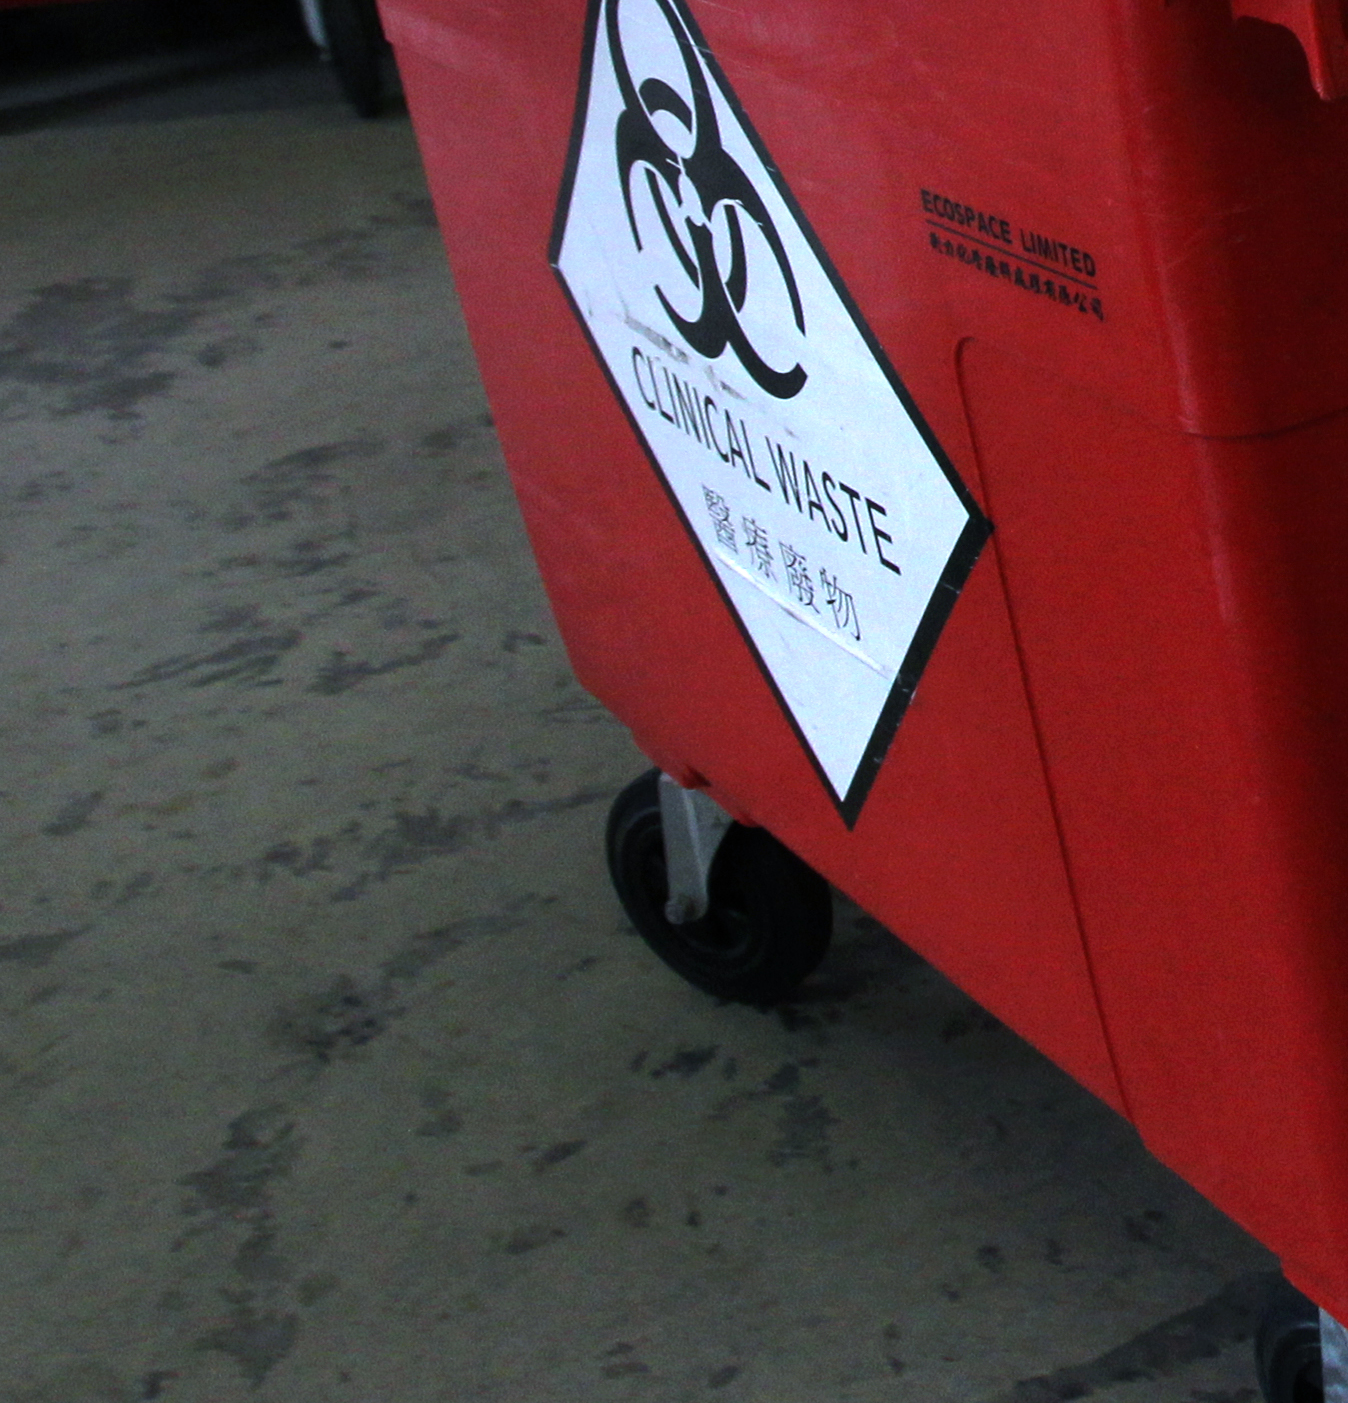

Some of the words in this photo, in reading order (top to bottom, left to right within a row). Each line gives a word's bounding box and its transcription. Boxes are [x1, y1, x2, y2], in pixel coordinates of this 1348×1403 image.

[920, 188, 1013, 245] ECOSPACE
[1019, 228, 1097, 278] LIMITED
[631, 346, 771, 493] CLINICAL
[764, 435, 902, 576] WASTE
[701, 483, 863, 642] 醫療廢物
